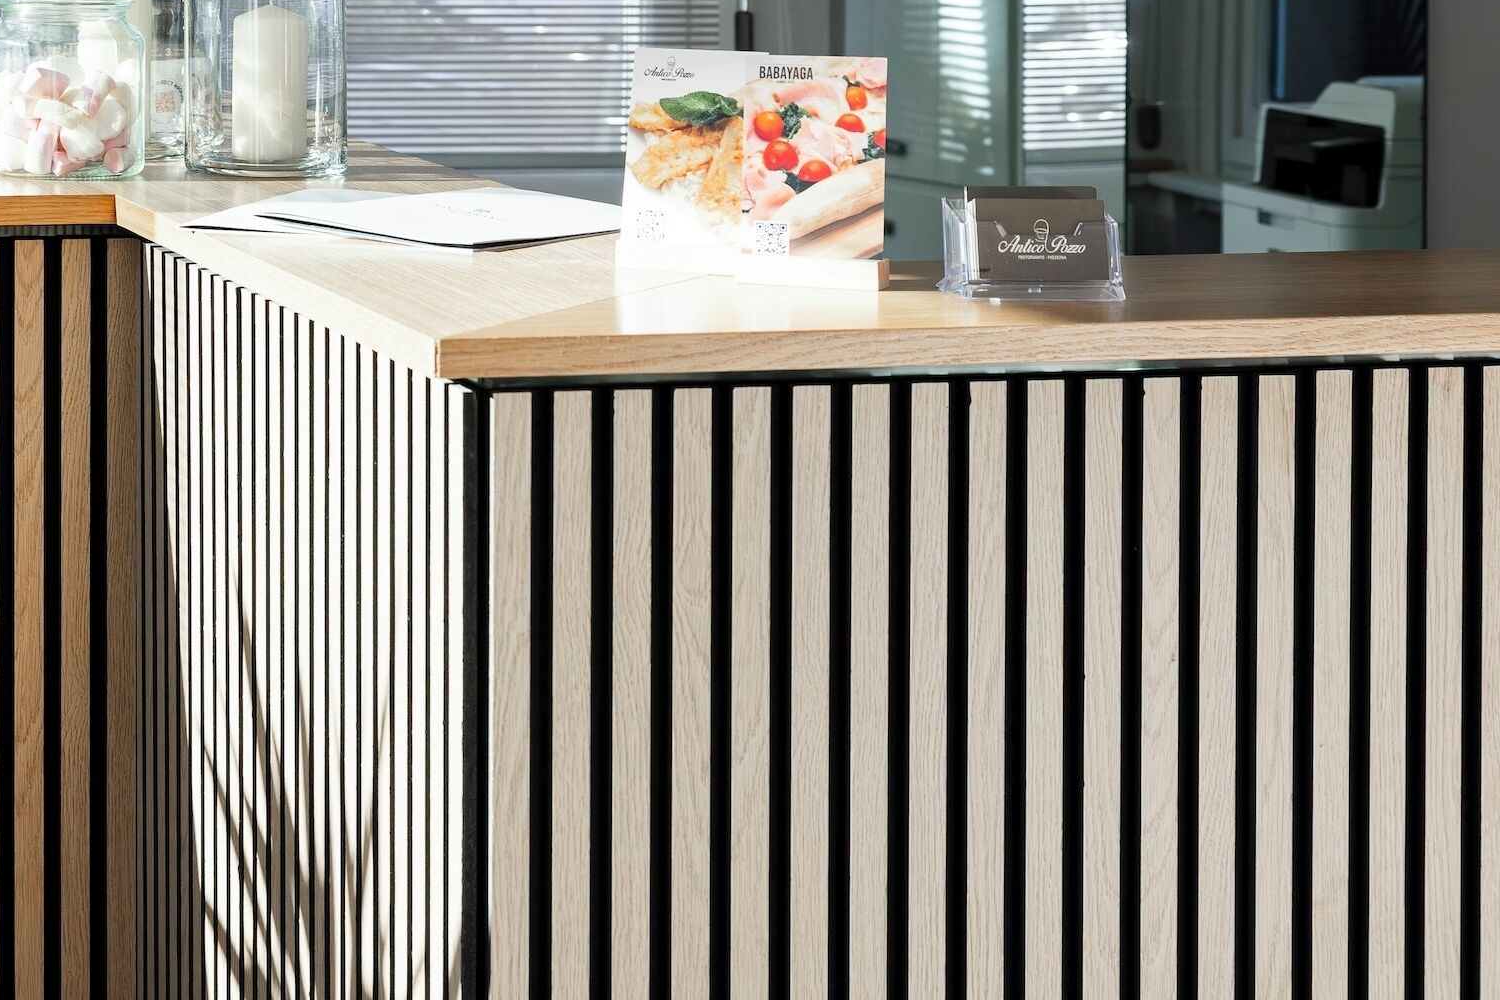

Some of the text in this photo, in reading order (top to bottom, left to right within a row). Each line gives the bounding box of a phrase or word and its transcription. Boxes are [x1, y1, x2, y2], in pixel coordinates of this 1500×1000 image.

[644, 66, 695, 78] Antico Pozzo
[759, 65, 814, 80] BABAYAGA
[997, 234, 1086, 254] Antico Pozzo
